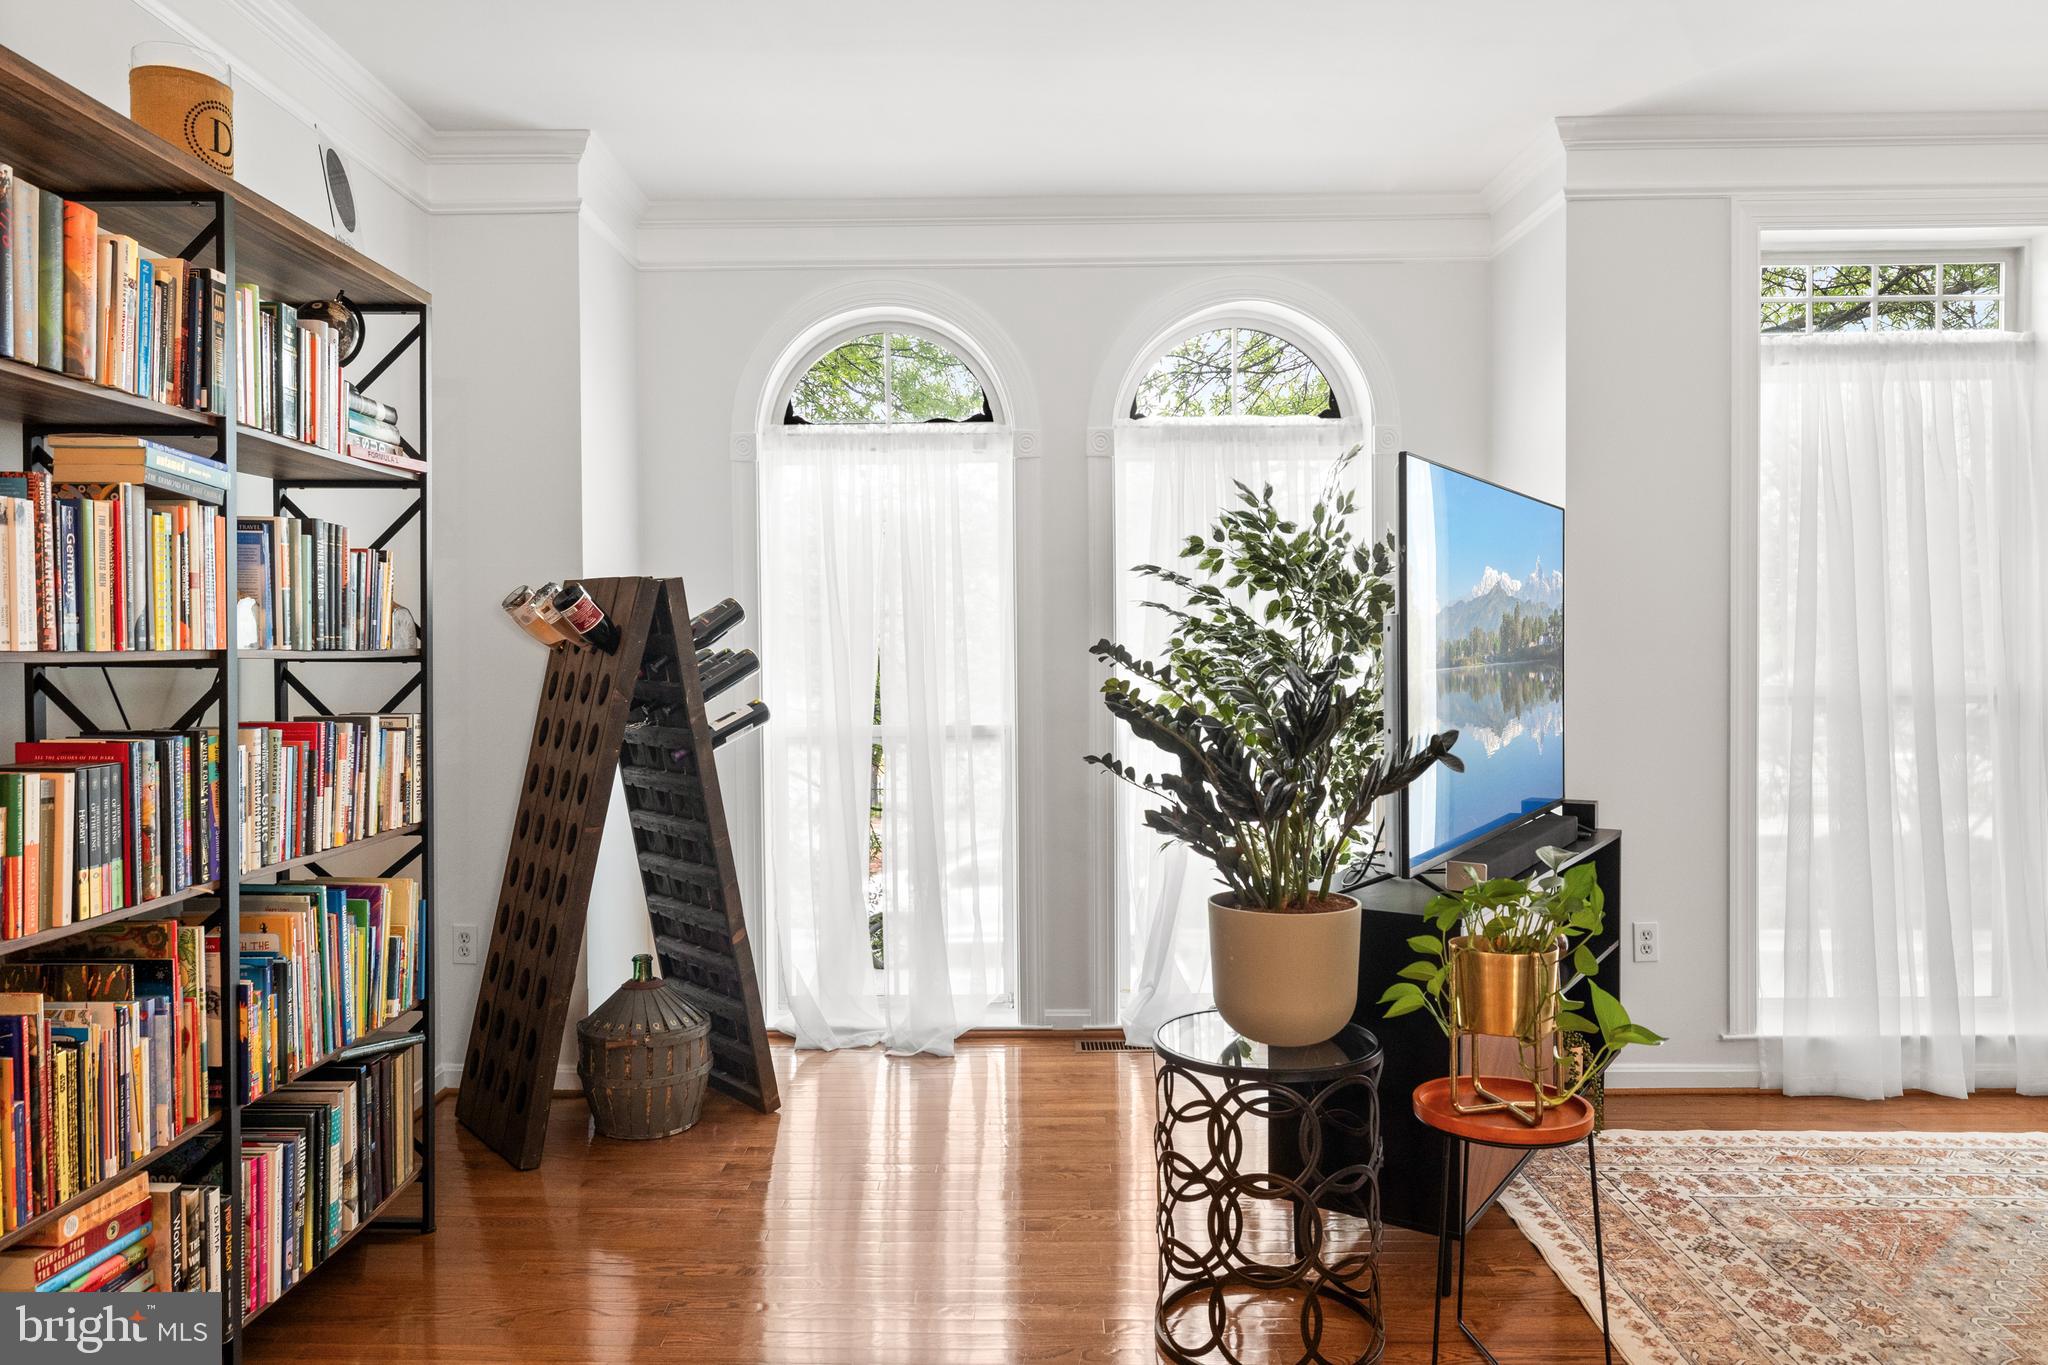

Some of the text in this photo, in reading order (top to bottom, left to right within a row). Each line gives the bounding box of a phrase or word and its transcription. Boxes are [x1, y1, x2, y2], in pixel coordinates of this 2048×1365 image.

[209, 117, 232, 157] D
[66, 533, 76, 600] Germany
[98, 515, 106, 588] THE MONUMENTS MEN
[45, 560, 55, 628] AMERICAN
[250, 941, 270, 950] THE
[36, 1236, 86, 1270] STAMPED FROM
[173, 1213, 181, 1287] World Art
[189, 1236, 200, 1251] THE
[38, 1247, 86, 1281] THE BEGINNING
